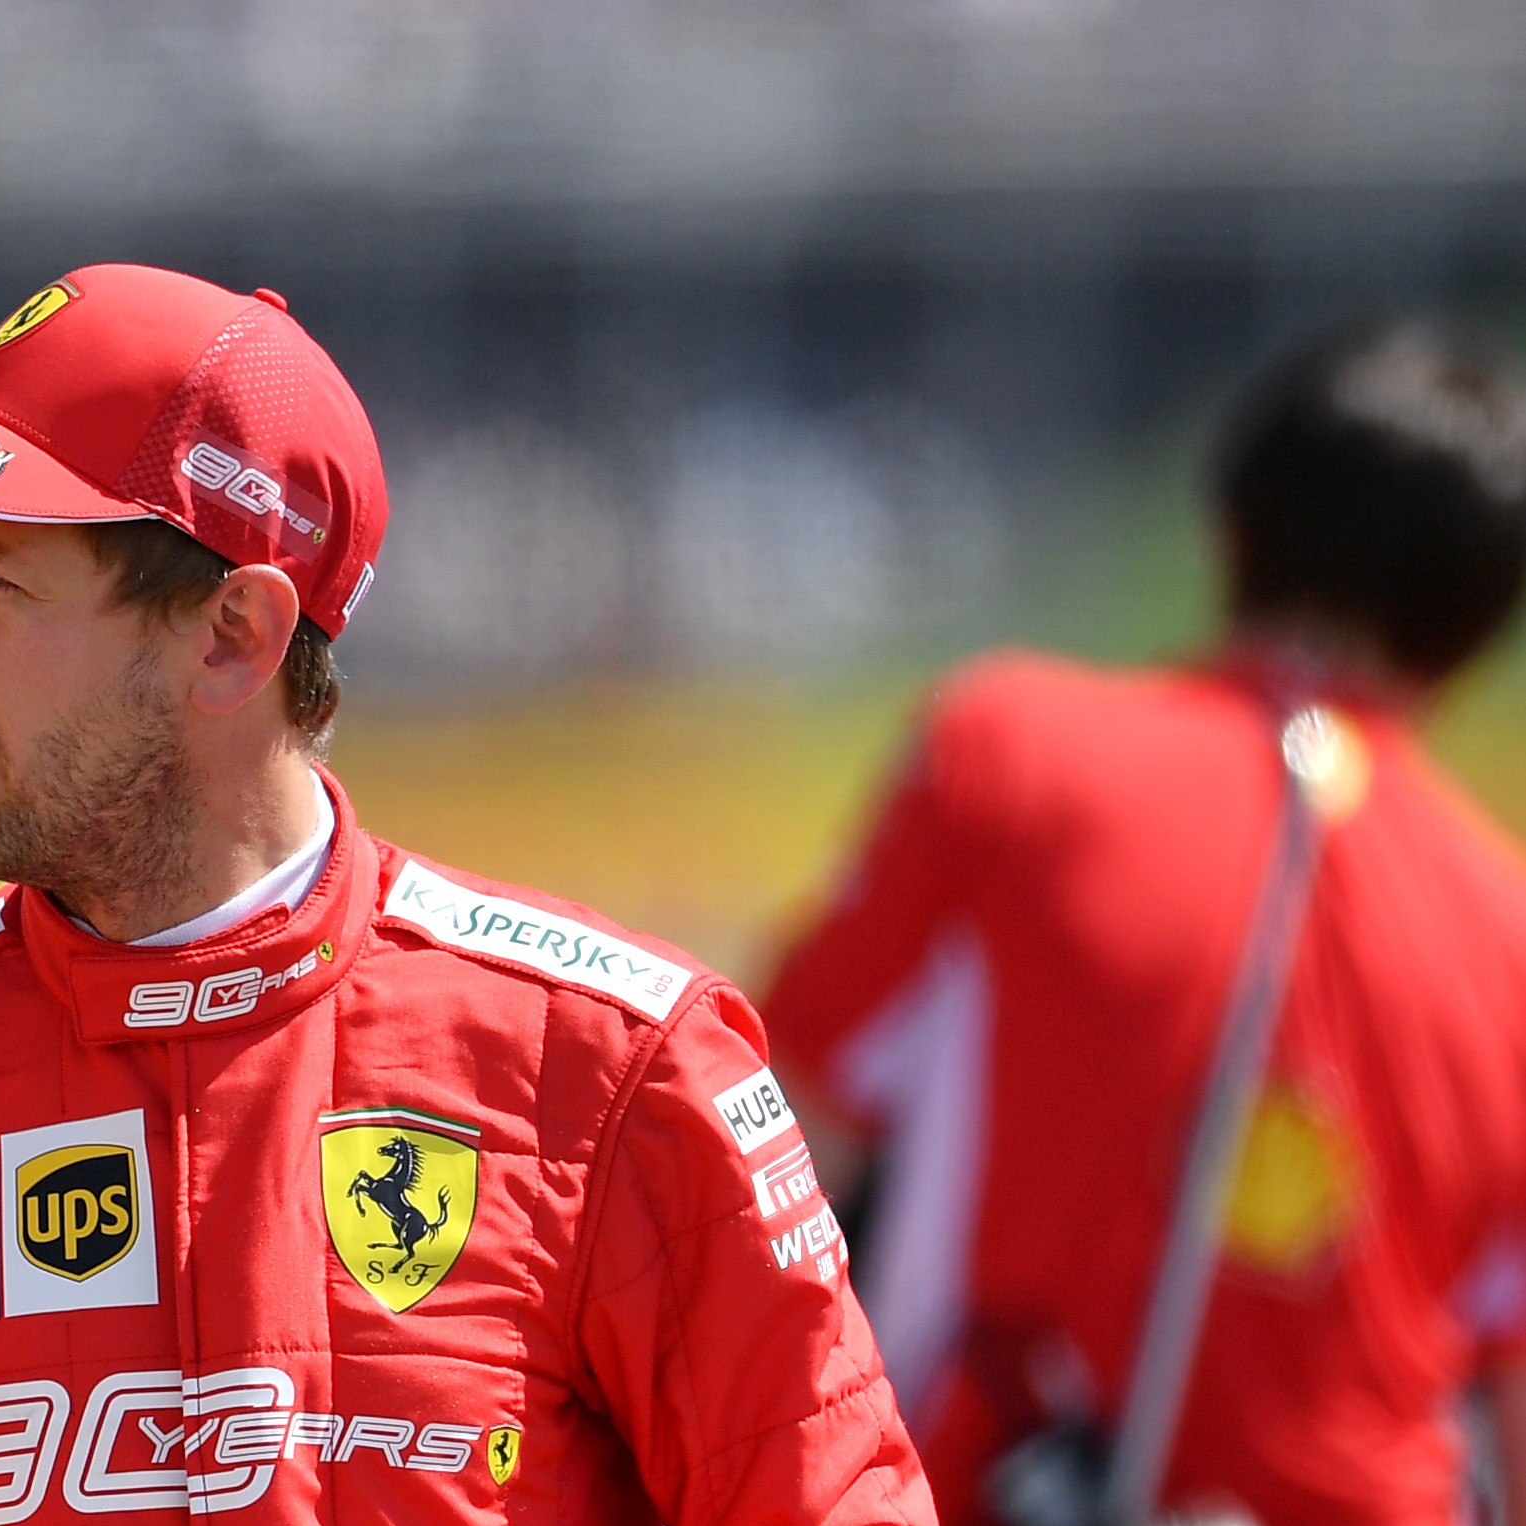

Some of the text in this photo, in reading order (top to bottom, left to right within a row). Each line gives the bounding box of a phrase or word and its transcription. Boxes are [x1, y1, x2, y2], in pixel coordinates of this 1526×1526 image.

[180, 441, 316, 536] 90 YEARS
[400, 878, 653, 984] KASPERSKY
[123, 951, 318, 1029] 90 YEARS
[25, 1185, 130, 1260] ups
[138, 1408, 483, 1473] YEARS
